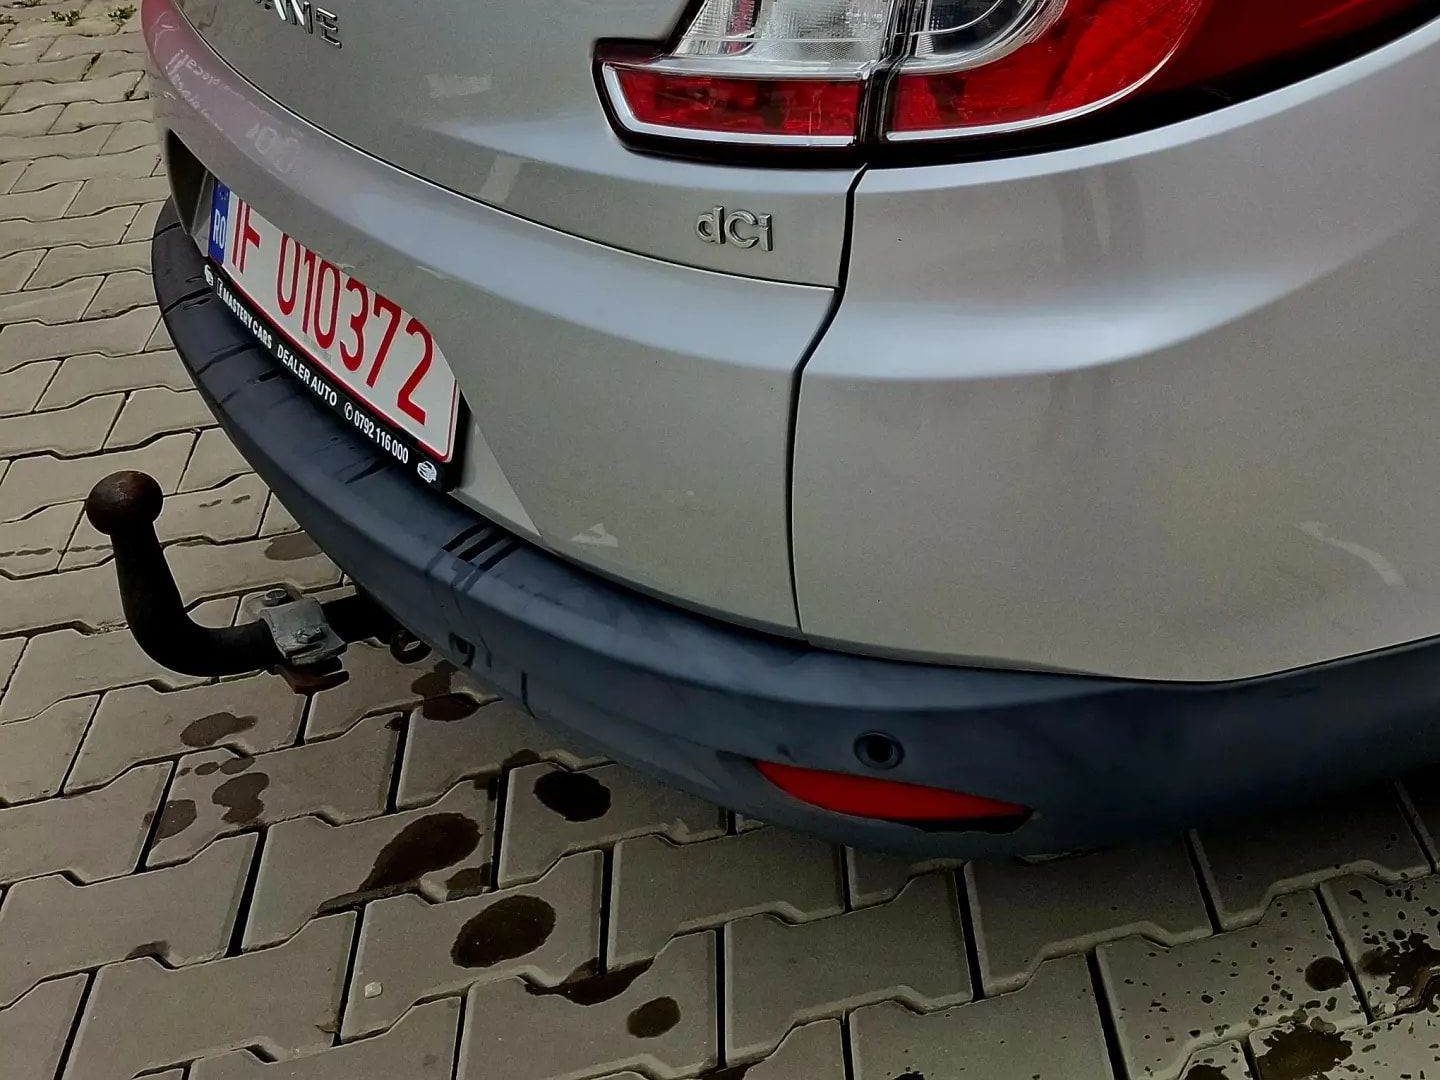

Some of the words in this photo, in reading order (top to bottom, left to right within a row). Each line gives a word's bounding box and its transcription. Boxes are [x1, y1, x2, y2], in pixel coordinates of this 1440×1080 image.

[212, 208, 226, 250] RO
[232, 199, 262, 275] IF
[276, 231, 435, 427] 010372
[222, 287, 253, 329] MASTERY
[252, 320, 273, 350] CARS
[276, 344, 310, 385] DEALER
[310, 376, 338, 407] AUTO
[353, 410, 374, 439] 0792
[375, 427, 392, 452] 116
[391, 443, 410, 464] 000
